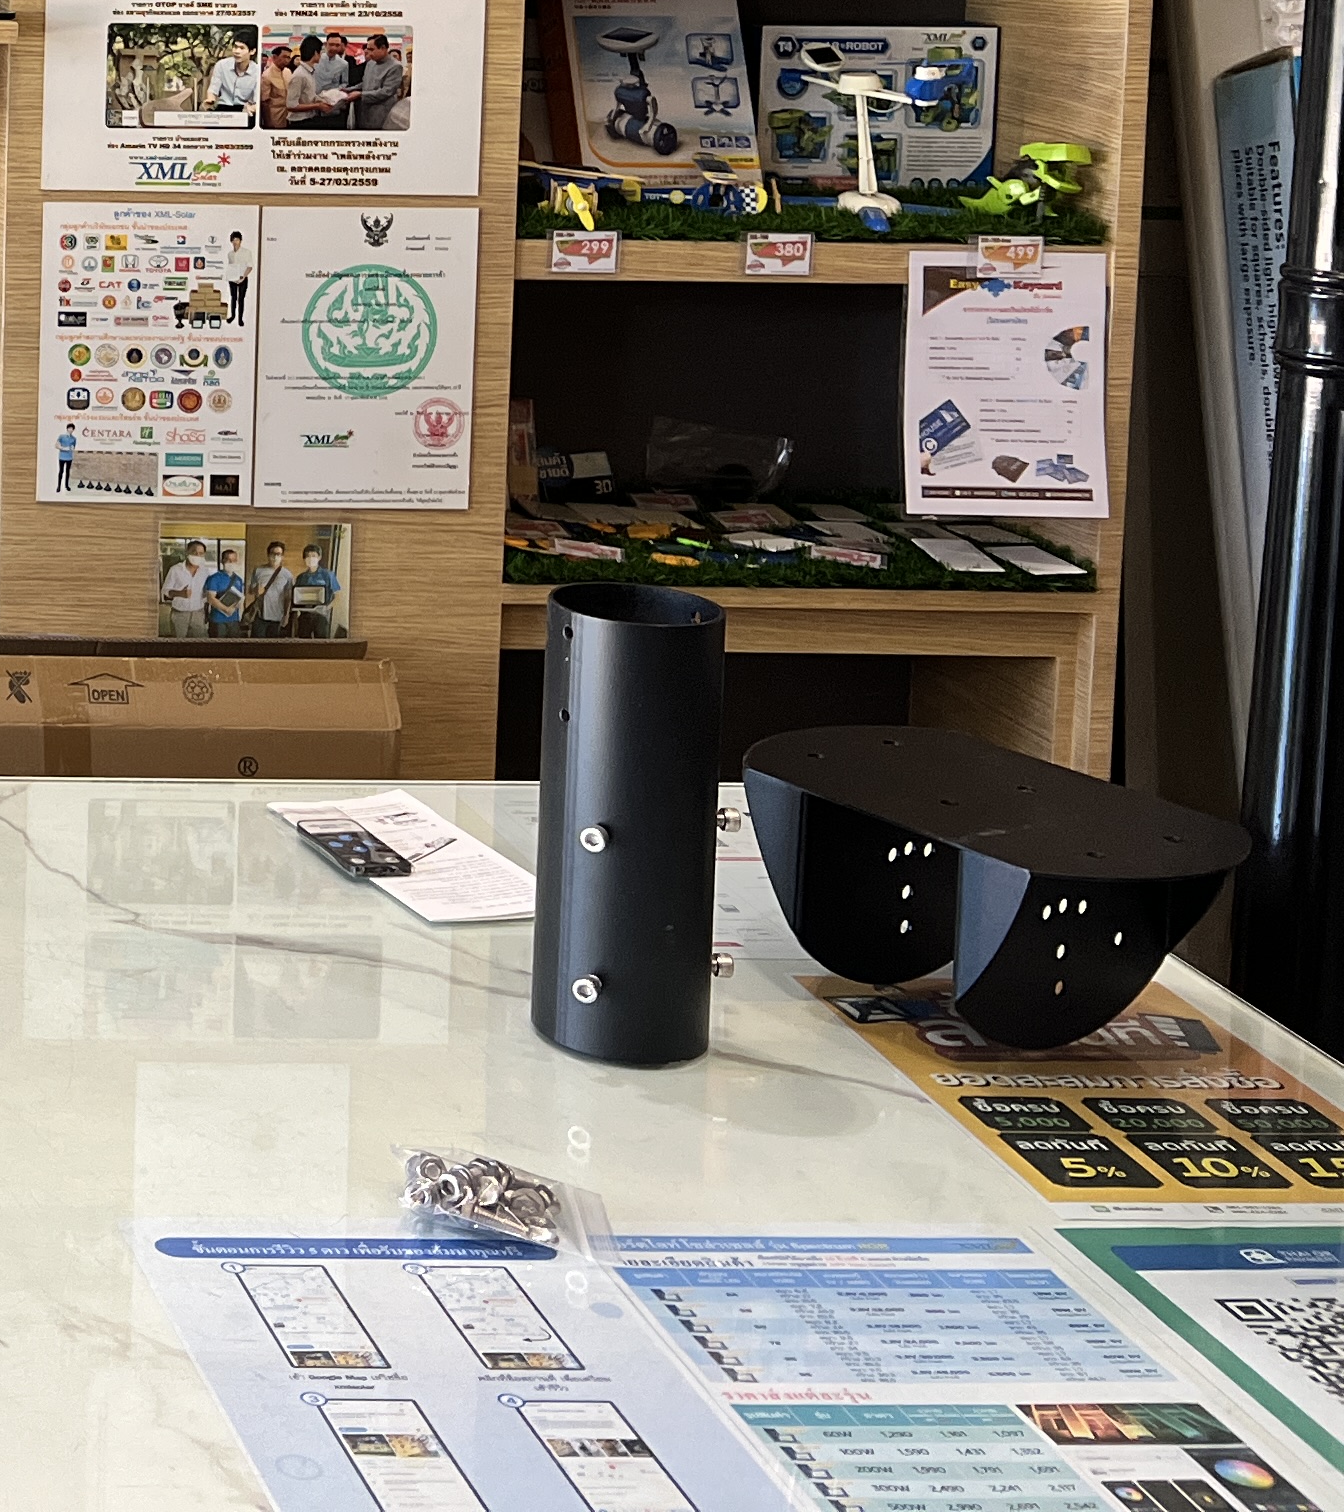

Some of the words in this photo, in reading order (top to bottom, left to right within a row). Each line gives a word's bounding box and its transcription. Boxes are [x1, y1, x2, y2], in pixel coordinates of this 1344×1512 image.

[846, 41, 884, 51] ROBOT
[137, 162, 193, 181] XML
[1244, 146, 1258, 212] Suitable
[1267, 141, 1286, 252] Features:
[1249, 216, 1259, 240] for
[582, 240, 609, 254] 299
[775, 242, 803, 256] 380
[1007, 246, 1034, 259] 499
[81, 426, 132, 439] CENTARA
[92, 688, 126, 703] OPEN
[973, 1096, 1060, 1115] ซื้อครบ
[1099, 1097, 1185, 1115] ซื้อครบ
[1222, 1097, 1308, 1116] ซื้อครบ
[1016, 1135, 1109, 1152] ลดทันที
[1144, 1135, 1237, 1153] ลดทันที
[1061, 1157, 1127, 1180] 5%
[1172, 1158, 1270, 1180] 10%
